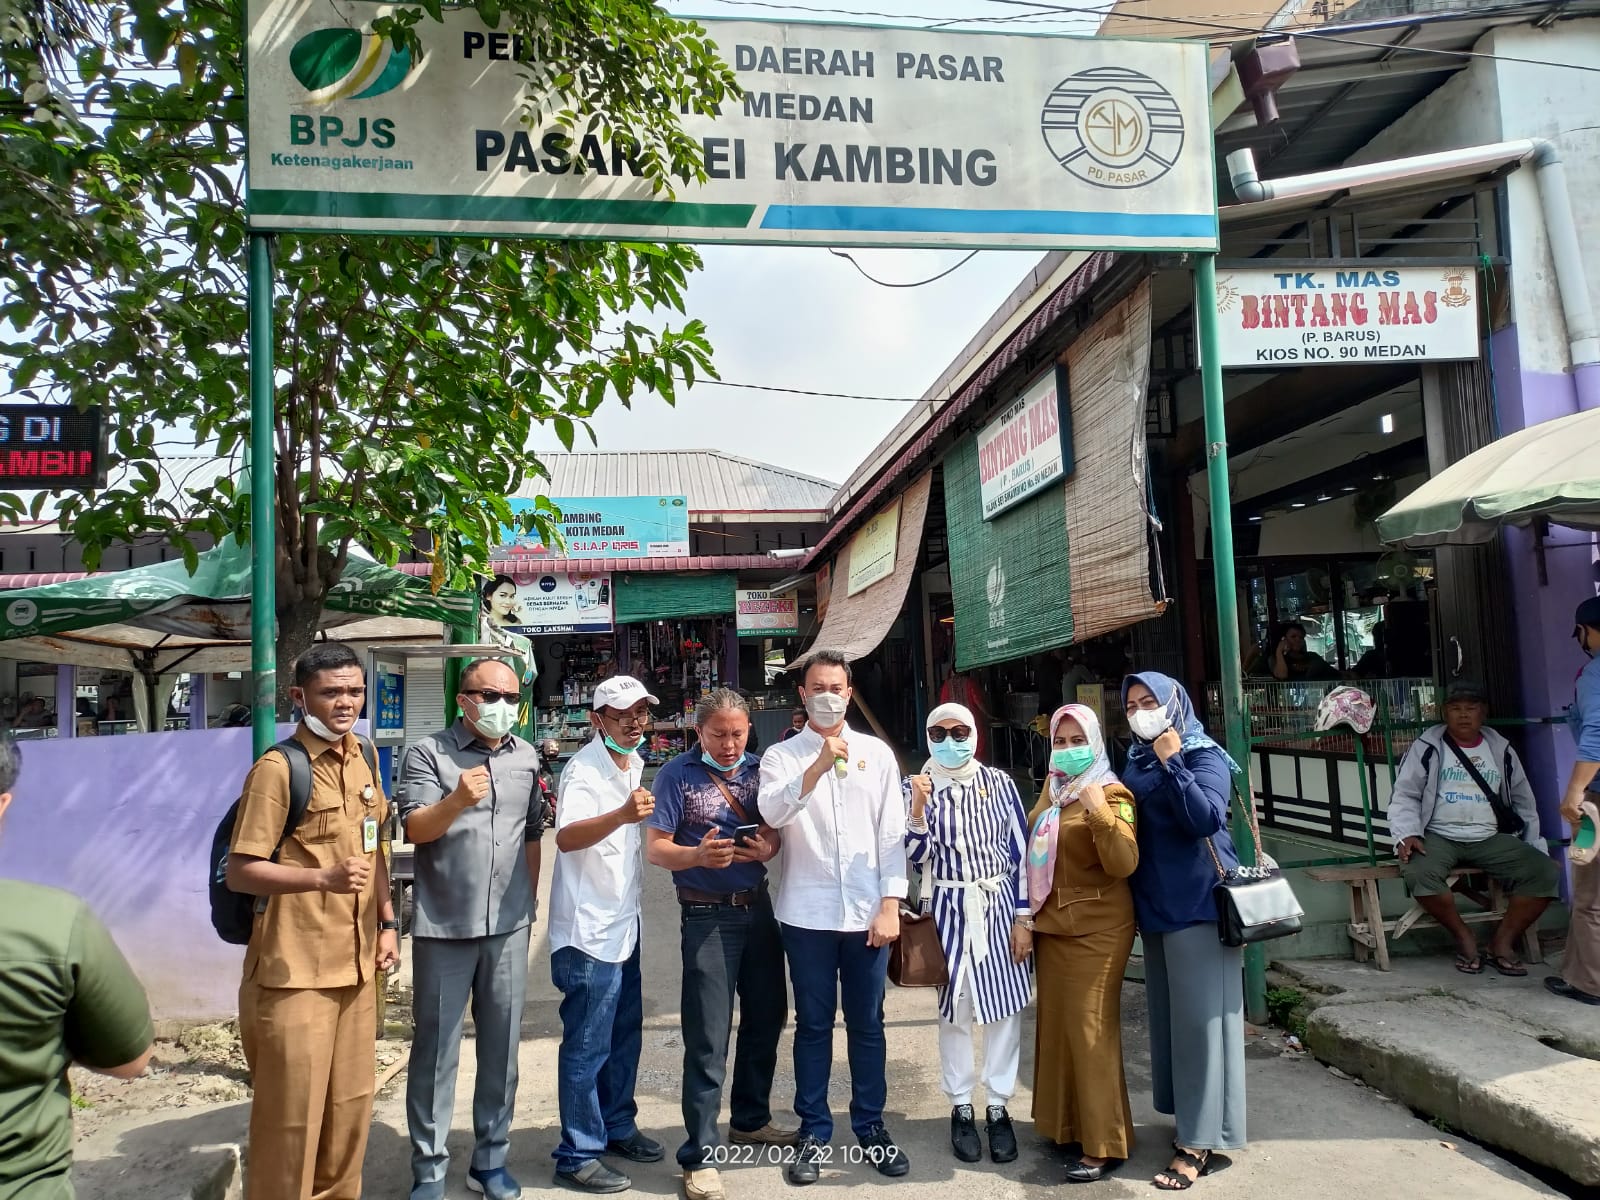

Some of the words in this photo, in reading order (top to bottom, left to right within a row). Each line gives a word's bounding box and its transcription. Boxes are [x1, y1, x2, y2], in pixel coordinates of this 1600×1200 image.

[736, 44, 874, 78] DAERAH
[897, 52, 1005, 83] PASAR
[743, 91, 873, 124] MEDAN
[290, 114, 396, 149] BPJS
[271, 153, 413, 171] Ketenagakerjaan
[475, 129, 644, 177] PASAR
[774, 142, 998, 187] KAMBING
[1108, 169, 1148, 183] PASAR
[1274, 273, 1324, 289] TK.
[1336, 270, 1400, 288] MAS
[1241, 292, 1369, 329] BINTANG
[1378, 291, 1438, 325] MAS
[1323, 330, 1381, 343] BARUS)
[1256, 348, 1298, 361] KIOS
[1304, 347, 1334, 360] NO.
[1339, 346, 1358, 359] 90
[1364, 344, 1426, 357] MEDAN
[23, 416, 60, 441] DI
[1000, 411, 1014, 427] TOKO
[980, 415, 1028, 485] BINTANG
[1028, 390, 1059, 451] MAS
[565, 526, 590, 537] KOTA
[592, 525, 625, 536] MEDAN
